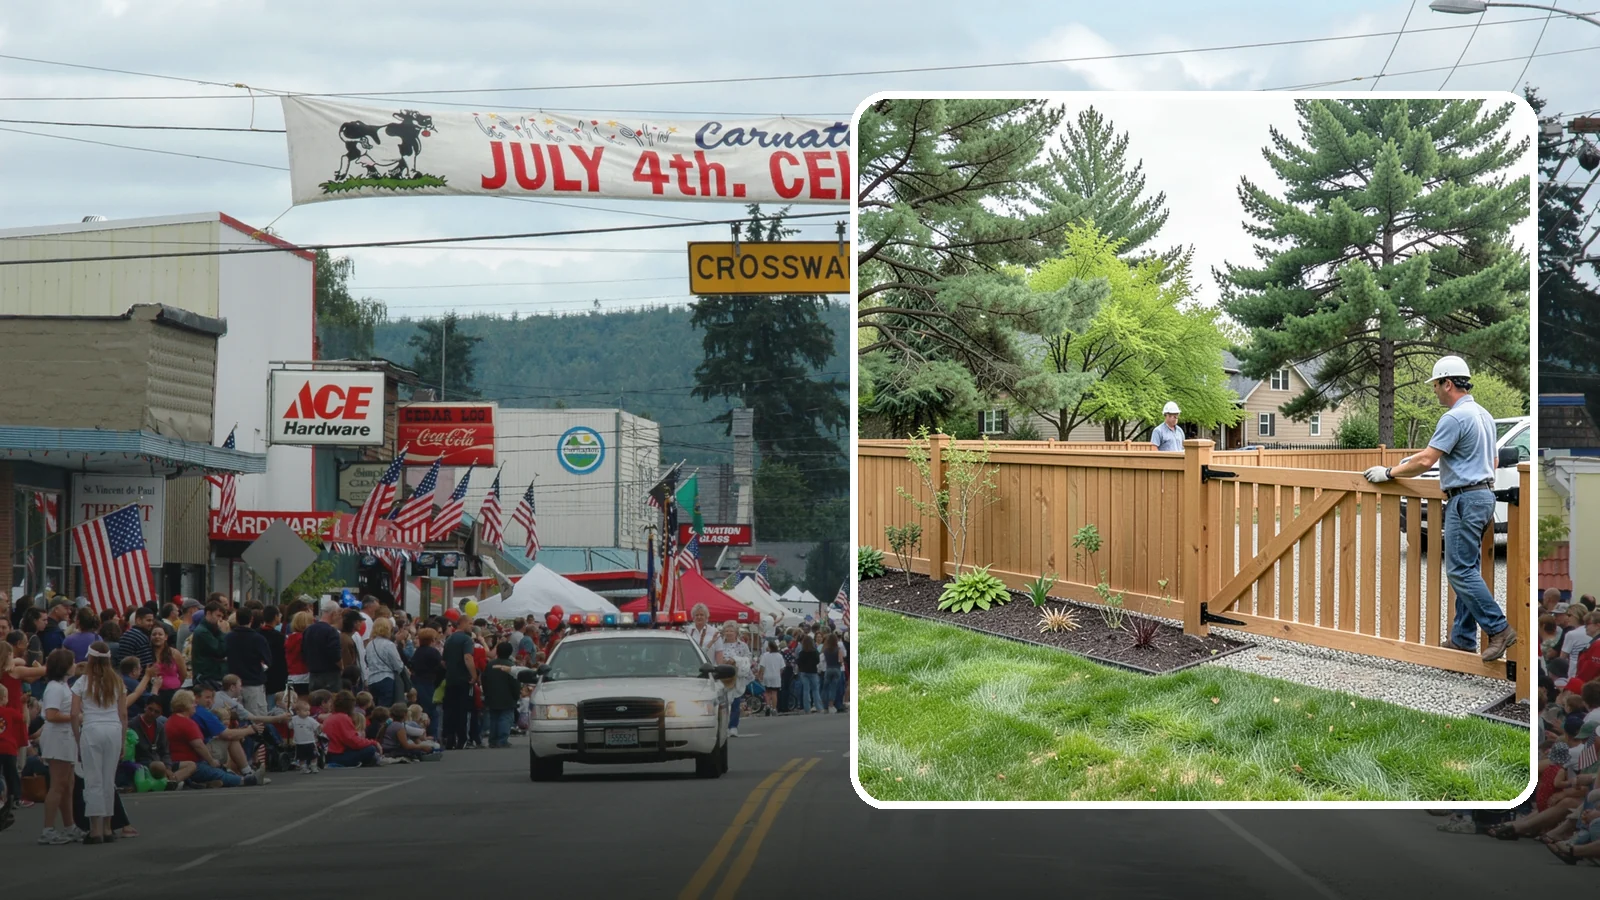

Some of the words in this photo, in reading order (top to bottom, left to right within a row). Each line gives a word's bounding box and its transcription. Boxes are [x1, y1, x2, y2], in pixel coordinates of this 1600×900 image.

[481, 141, 604, 192] JULY
[632, 150, 746, 197] 4th.
[697, 254, 850, 280] CROSSWA
[283, 380, 373, 420] ACE
[405, 409, 452, 422] CEDAR
[283, 421, 371, 436] Hardware
[353, 467, 386, 480] Simpl
[96, 485, 124, 495] Vincent
[126, 486, 135, 495] de
[138, 486, 155, 495] Paul
[688, 526, 741, 535] CRNATION
[699, 535, 730, 543] GLASS
